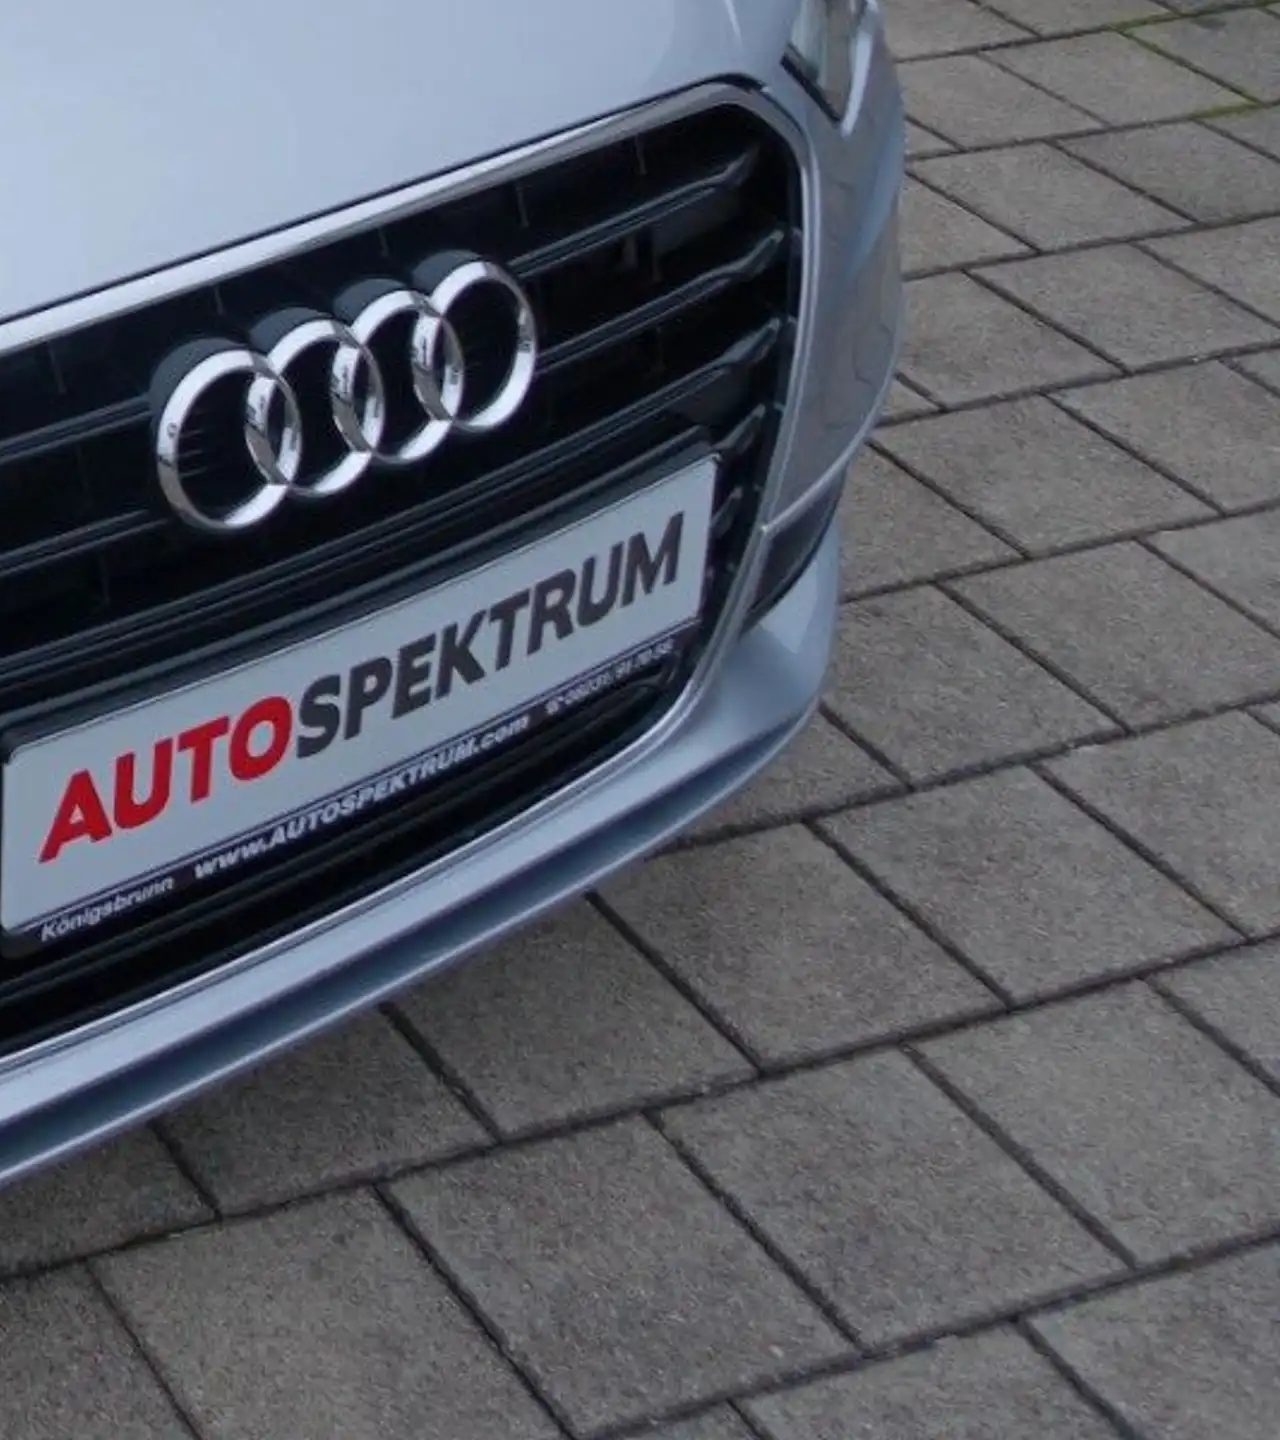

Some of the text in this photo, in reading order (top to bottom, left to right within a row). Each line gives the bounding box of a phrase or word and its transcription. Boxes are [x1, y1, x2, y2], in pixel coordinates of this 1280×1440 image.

[40, 513, 685, 862] AUTOSPEKTRUM
[41, 713, 529, 942] Königsbrunn www.AUTOSPEKTRUM.com
